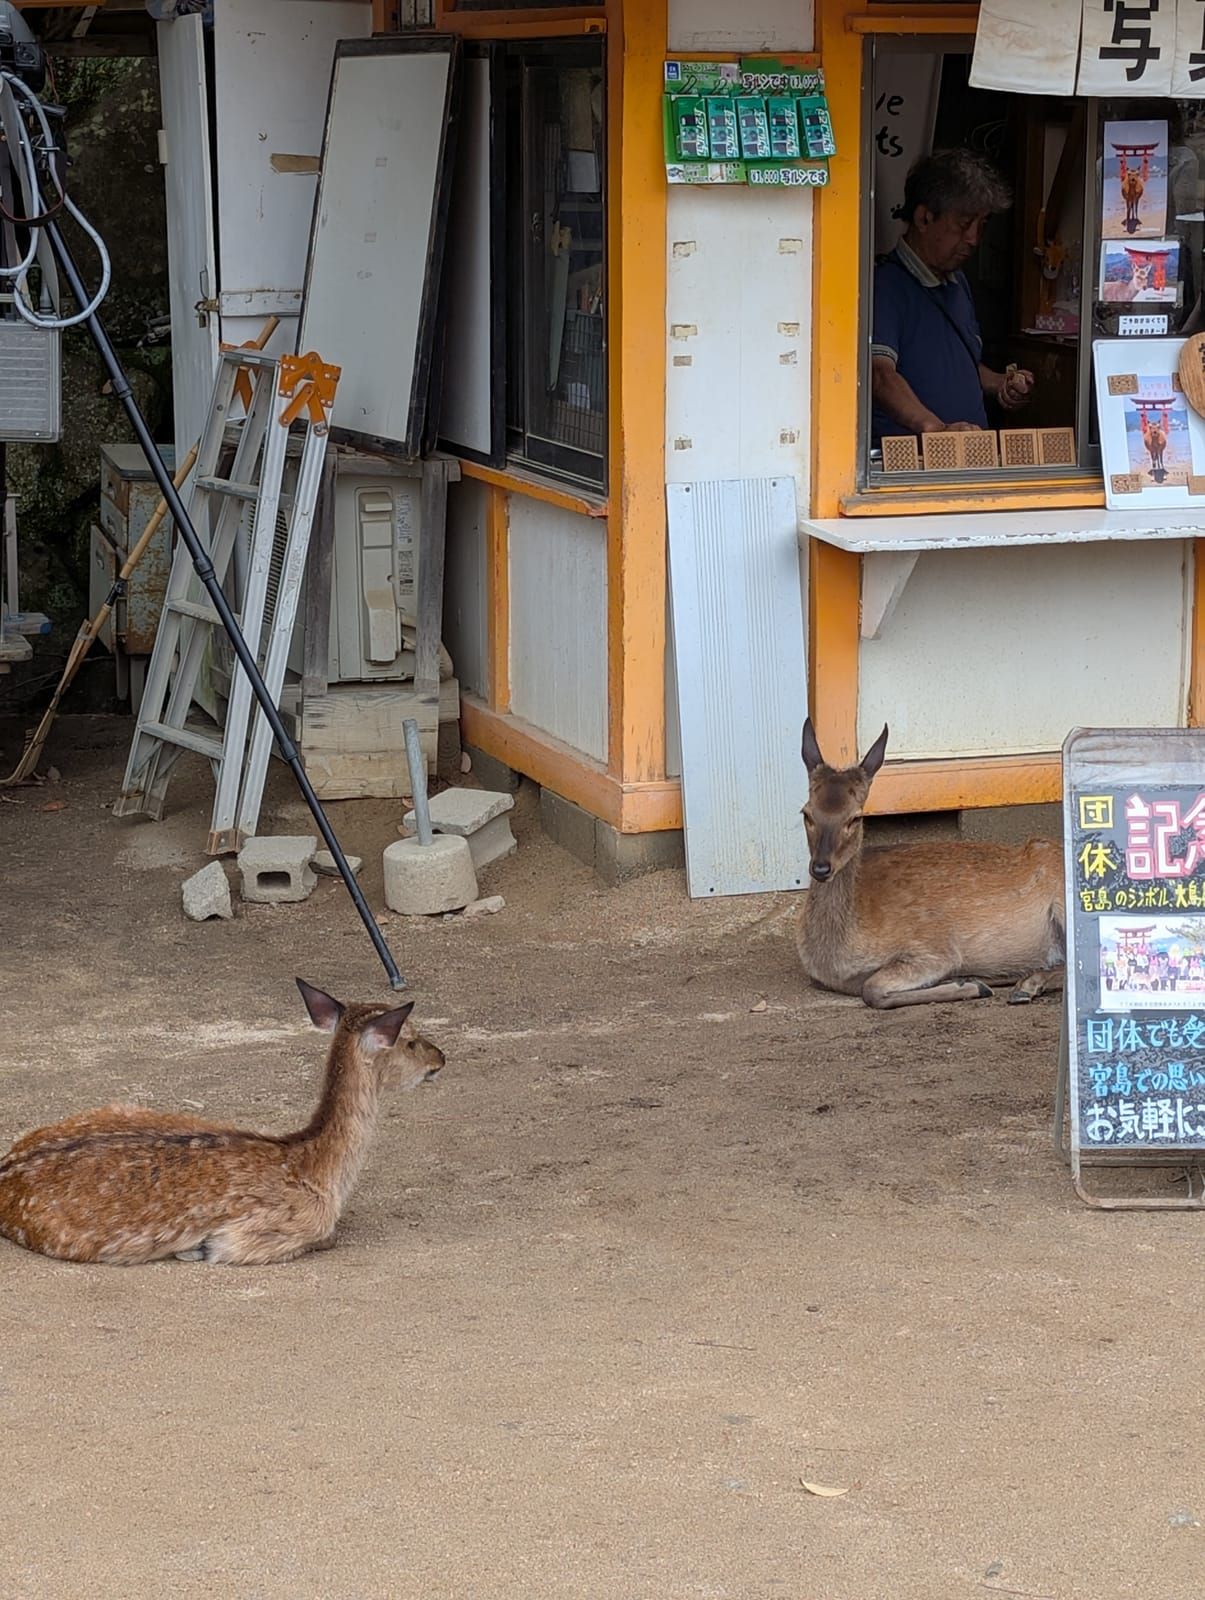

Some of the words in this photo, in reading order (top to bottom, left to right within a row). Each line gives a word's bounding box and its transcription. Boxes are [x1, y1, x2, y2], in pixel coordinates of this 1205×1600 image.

[779, 168, 827, 185] 写ルンです
